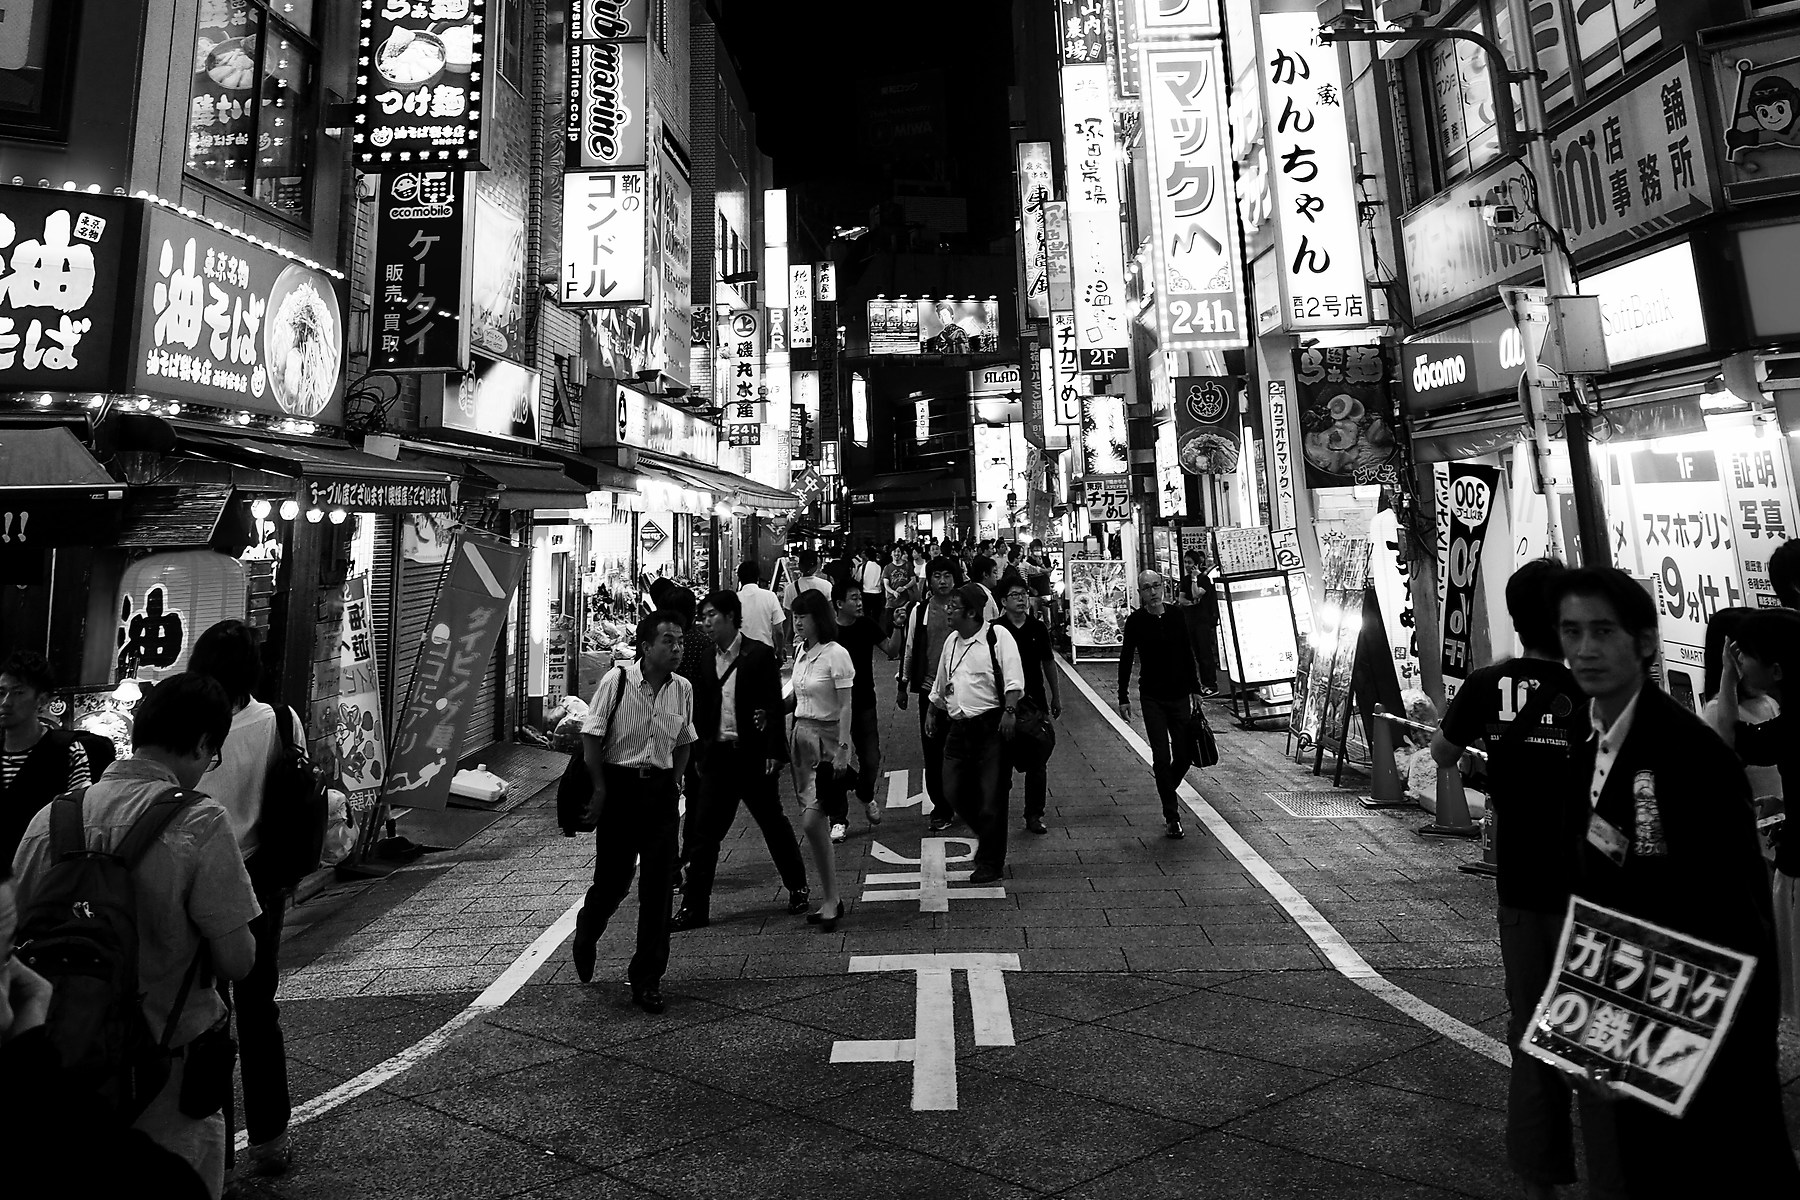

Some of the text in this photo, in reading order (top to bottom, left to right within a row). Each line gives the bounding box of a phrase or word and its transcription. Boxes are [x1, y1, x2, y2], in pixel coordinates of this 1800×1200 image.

[375, 84, 466, 118] つけ麺
[1270, 49, 1331, 275] かんちゃん
[622, 175, 642, 211] 靴の
[389, 204, 454, 220] ecomobile
[583, 176, 617, 298] コンドル
[204, 247, 250, 289] 東京名物
[566, 262, 578, 299] 1F
[404, 229, 440, 355] ケータイ
[770, 309, 785, 349] BAR
[1169, 299, 1236, 334] 24h
[1058, 327, 1079, 420] チカラめし
[1090, 349, 1117, 366] 2F
[1412, 356, 1466, 393] docomo
[737, 342, 754, 419] 磯丸水産
[984, 369, 1021, 384] ALAD
[1269, 383, 1286, 395] 2F
[731, 425, 758, 435] 24h
[1353, 464, 1399, 486] どんどん
[1677, 454, 1694, 479] 1F
[1732, 450, 1778, 489] 証明
[1087, 482, 1103, 491] 東京
[1087, 491, 1129, 508] チカラ
[1106, 505, 1130, 519] めし
[1739, 499, 1787, 540] 写真
[1278, 549, 1301, 567] 2F
[1680, 647, 1704, 663] SMART
[1568, 927, 1728, 1019] カラオケ
[1550, 990, 1656, 1065] の鉄人
